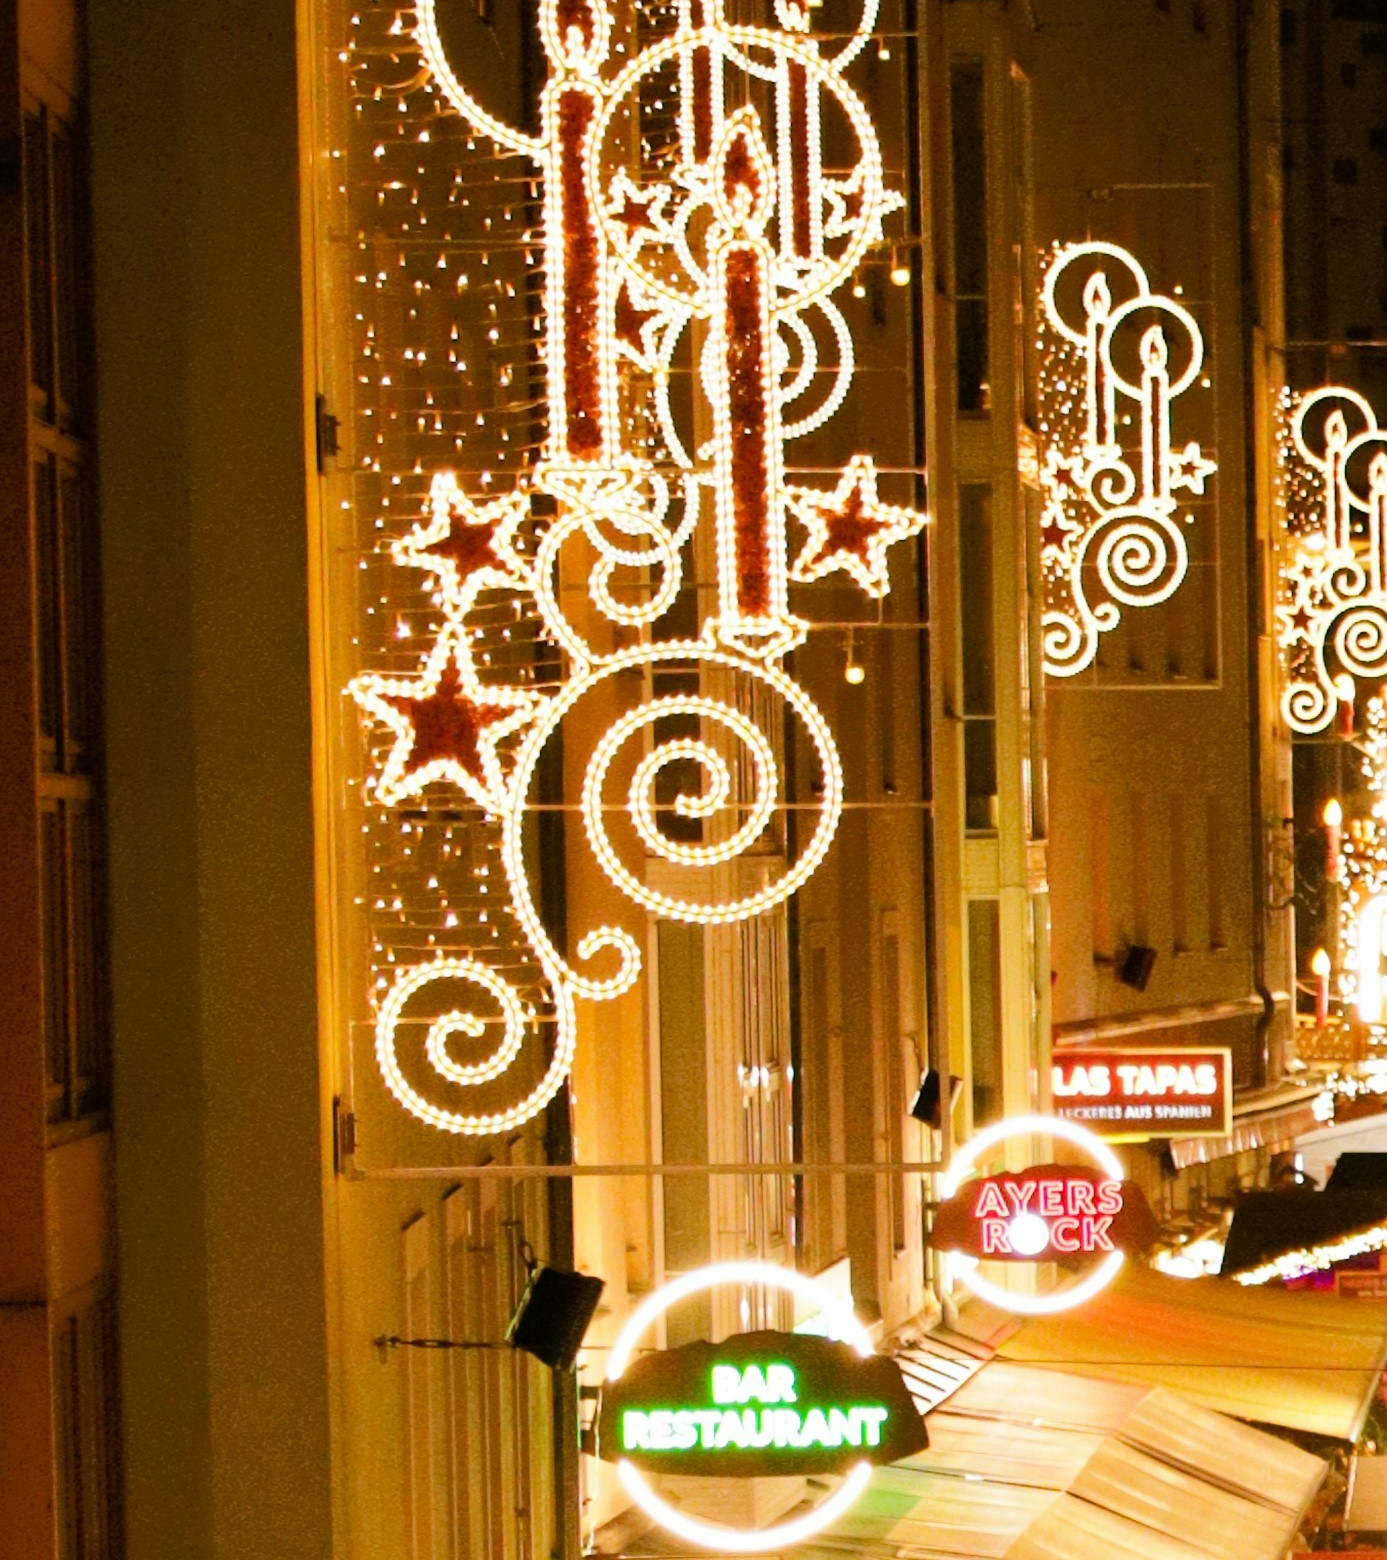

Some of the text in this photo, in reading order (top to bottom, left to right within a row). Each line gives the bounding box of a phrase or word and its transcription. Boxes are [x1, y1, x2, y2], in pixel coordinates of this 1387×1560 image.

[1051, 1064, 1218, 1096] LAS TAPAS
[1058, 1104, 1212, 1120] LECKERES AUS SPANIEN
[975, 1180, 1123, 1217] AYERS
[982, 1216, 1116, 1254] RCK
[712, 1364, 797, 1404] BAR
[622, 1407, 889, 1452] RESTAURANT
